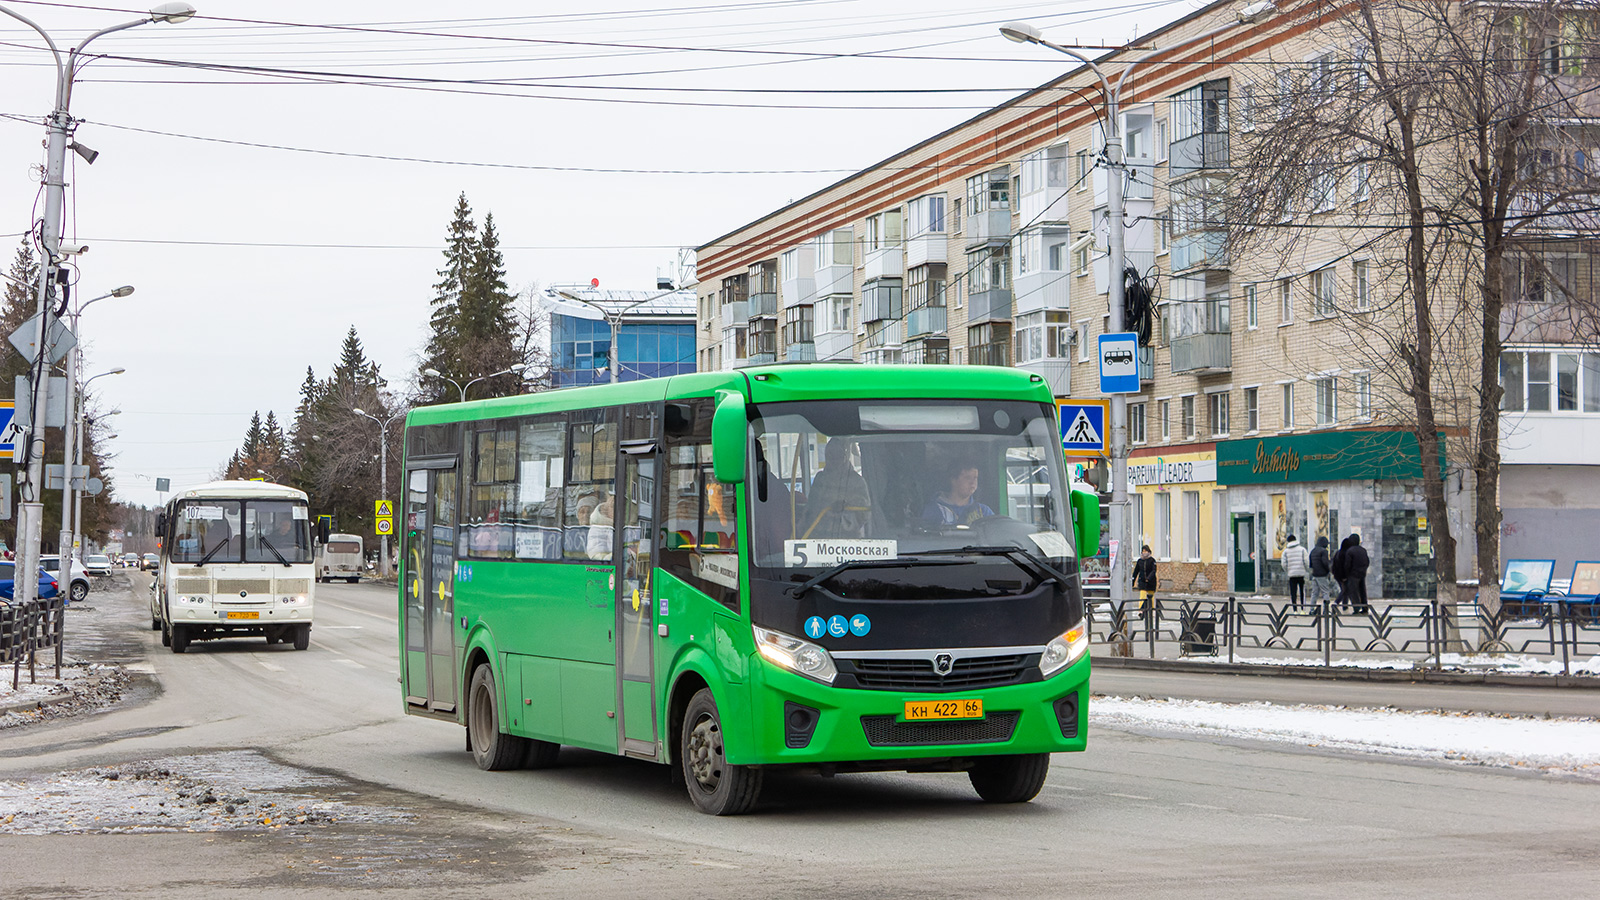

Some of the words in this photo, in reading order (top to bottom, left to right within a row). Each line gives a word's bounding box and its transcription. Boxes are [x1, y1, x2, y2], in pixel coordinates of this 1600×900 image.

[1252, 440, 1299, 480] Янтарь
[1128, 466, 1157, 484] PARFUM
[1164, 462, 1193, 482] LEADER
[187, 506, 200, 518] 107
[792, 543, 808, 567] 5
[817, 543, 889, 556] Московская
[934, 702, 958, 717] 422
[965, 701, 978, 712] 66
